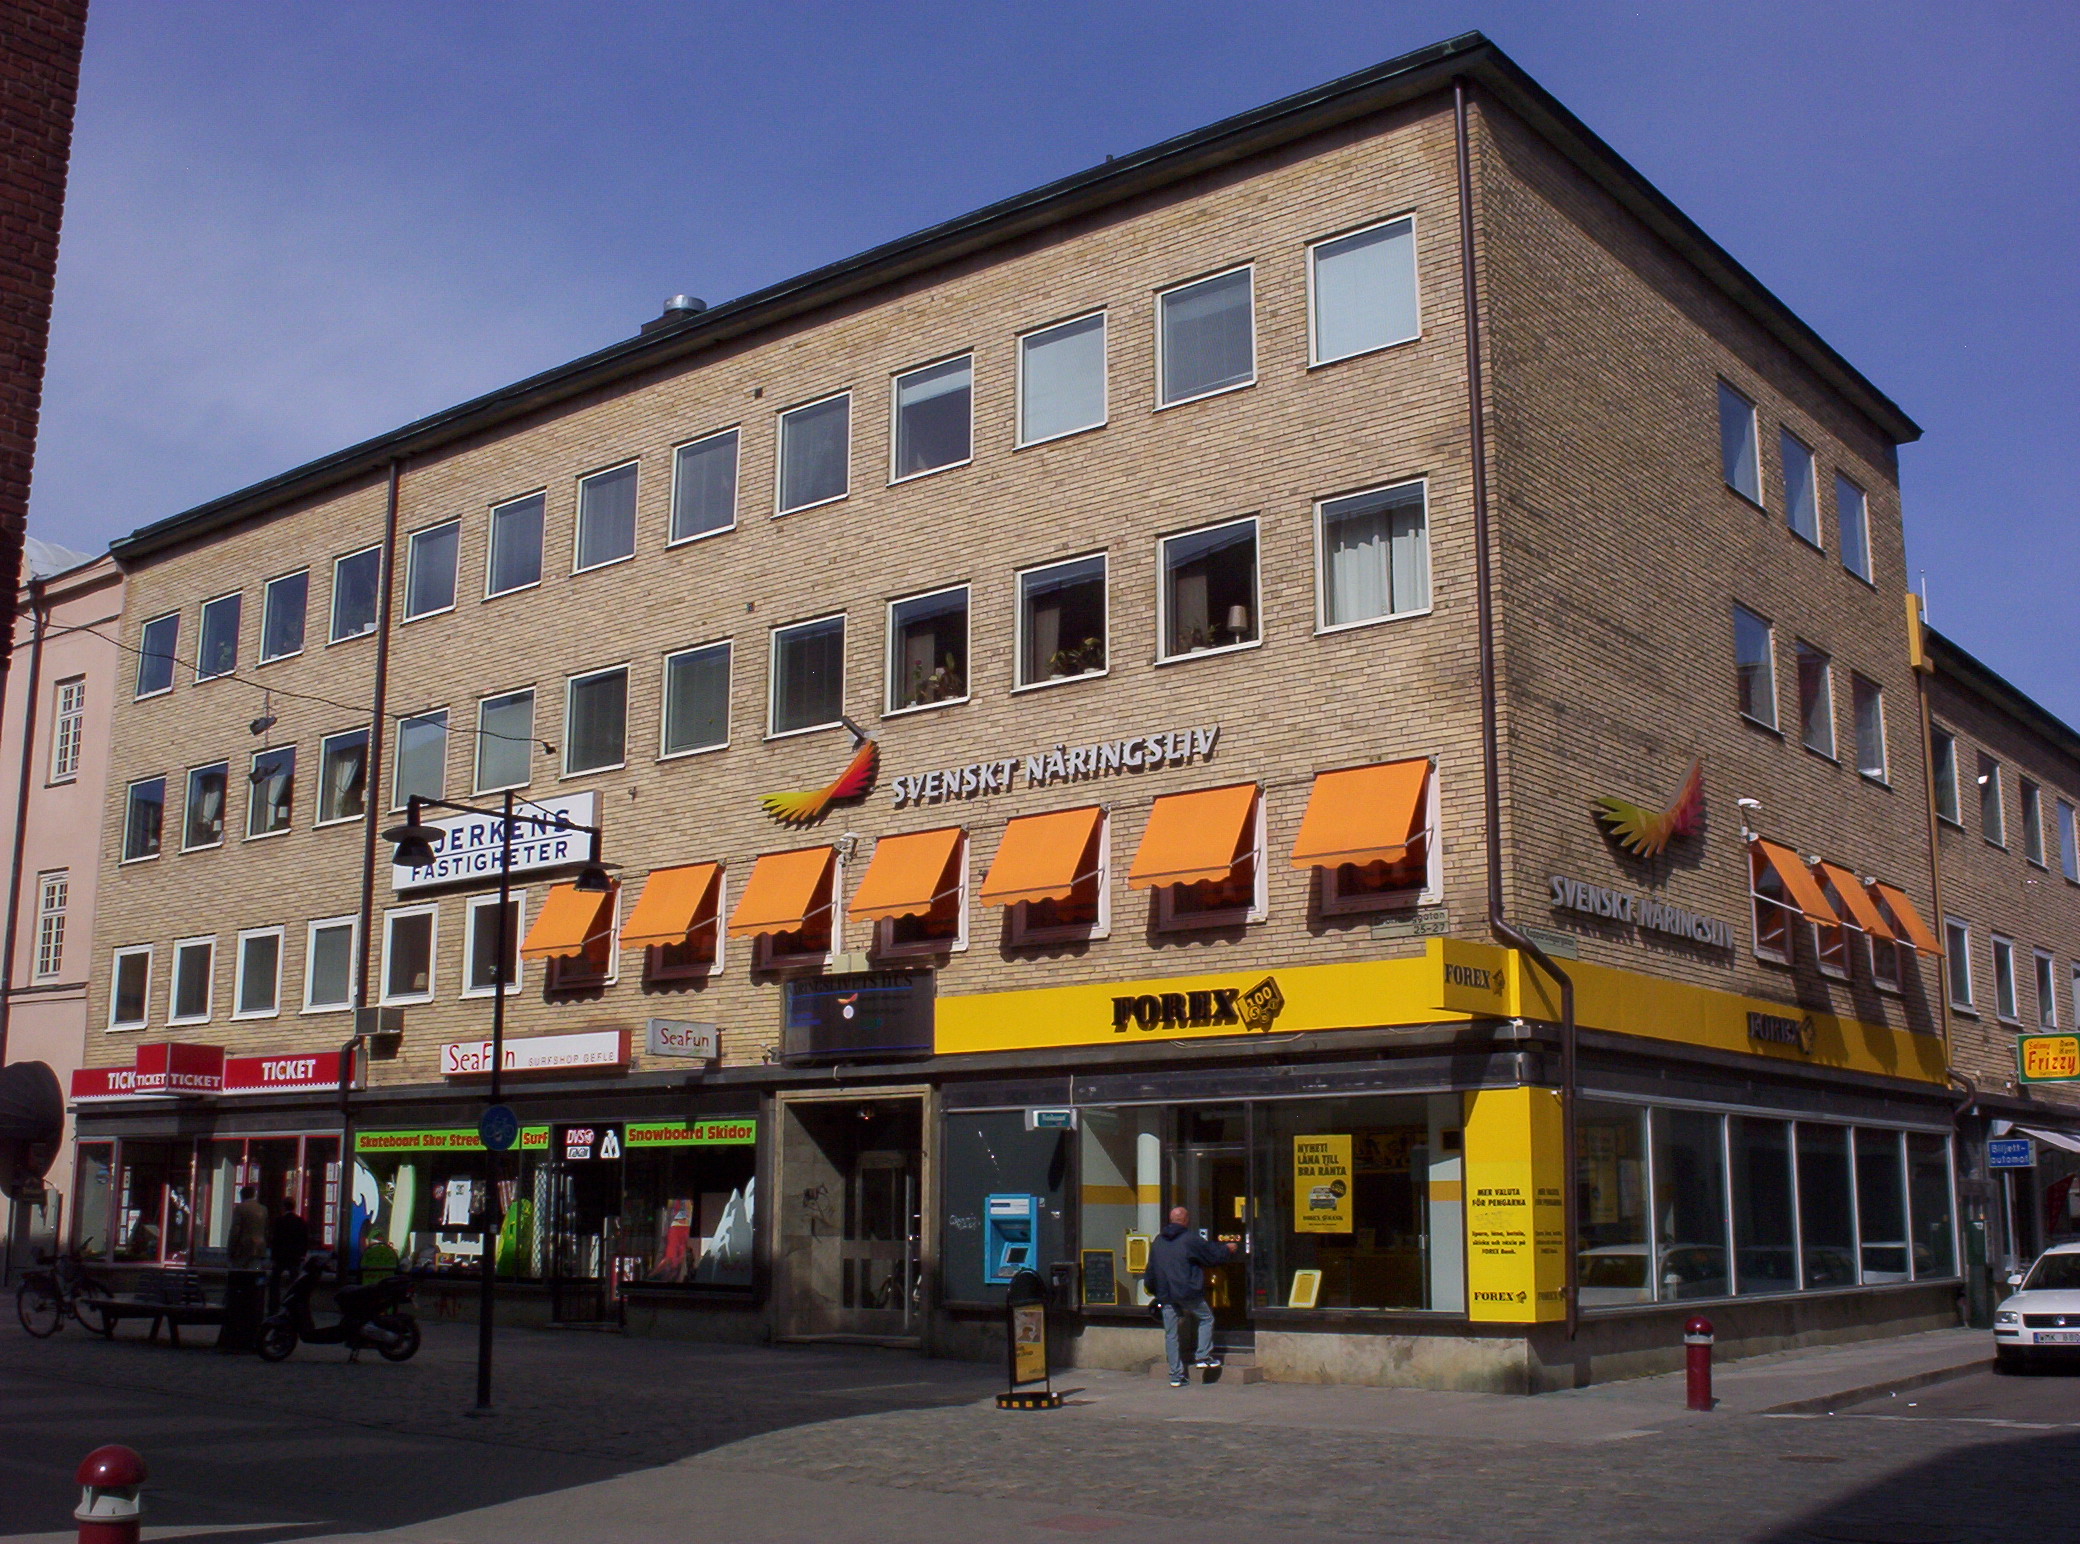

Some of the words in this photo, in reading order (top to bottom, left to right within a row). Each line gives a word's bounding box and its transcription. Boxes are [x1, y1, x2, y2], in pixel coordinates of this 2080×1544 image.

[891, 758, 1018, 803] SVENSKT
[1025, 726, 1220, 781] NÄRINGSLIV
[416, 808, 571, 854] JERKÉNS
[411, 841, 568, 882] FASTIGHETER
[1551, 875, 1636, 923] SVENSKT
[1636, 896, 1736, 949] NÄRINGSLIV
[1413, 923, 1446, 935] 25-27
[1444, 963, 1491, 990] FOREX
[1111, 988, 1240, 1028] FOREX
[660, 1028, 710, 1048] SeaFun
[449, 1043, 516, 1072] SeaFn
[528, 1054, 579, 1067] SURFSHOP
[583, 1051, 614, 1063] GEFLE
[2028, 1050, 2076, 1075] Frizzy
[262, 1059, 317, 1081] TICKET
[107, 1071, 137, 1090] TICK
[136, 1073, 167, 1087] TICKET
[170, 1073, 221, 1088] TICKET
[360, 1134, 420, 1148] Skateboard
[423, 1134, 447, 1146] Skor
[523, 1132, 549, 1145] Surf
[628, 1126, 704, 1142] Snowboard
[707, 1124, 752, 1140] Skidor
[1321, 1154, 1339, 1165] TILL
[1298, 1167, 1316, 1176] BRA
[1494, 1188, 1520, 1196] VALUTA
[1488, 1199, 1526, 1207] PENGARNA
[1474, 1291, 1514, 1302] FOREX
